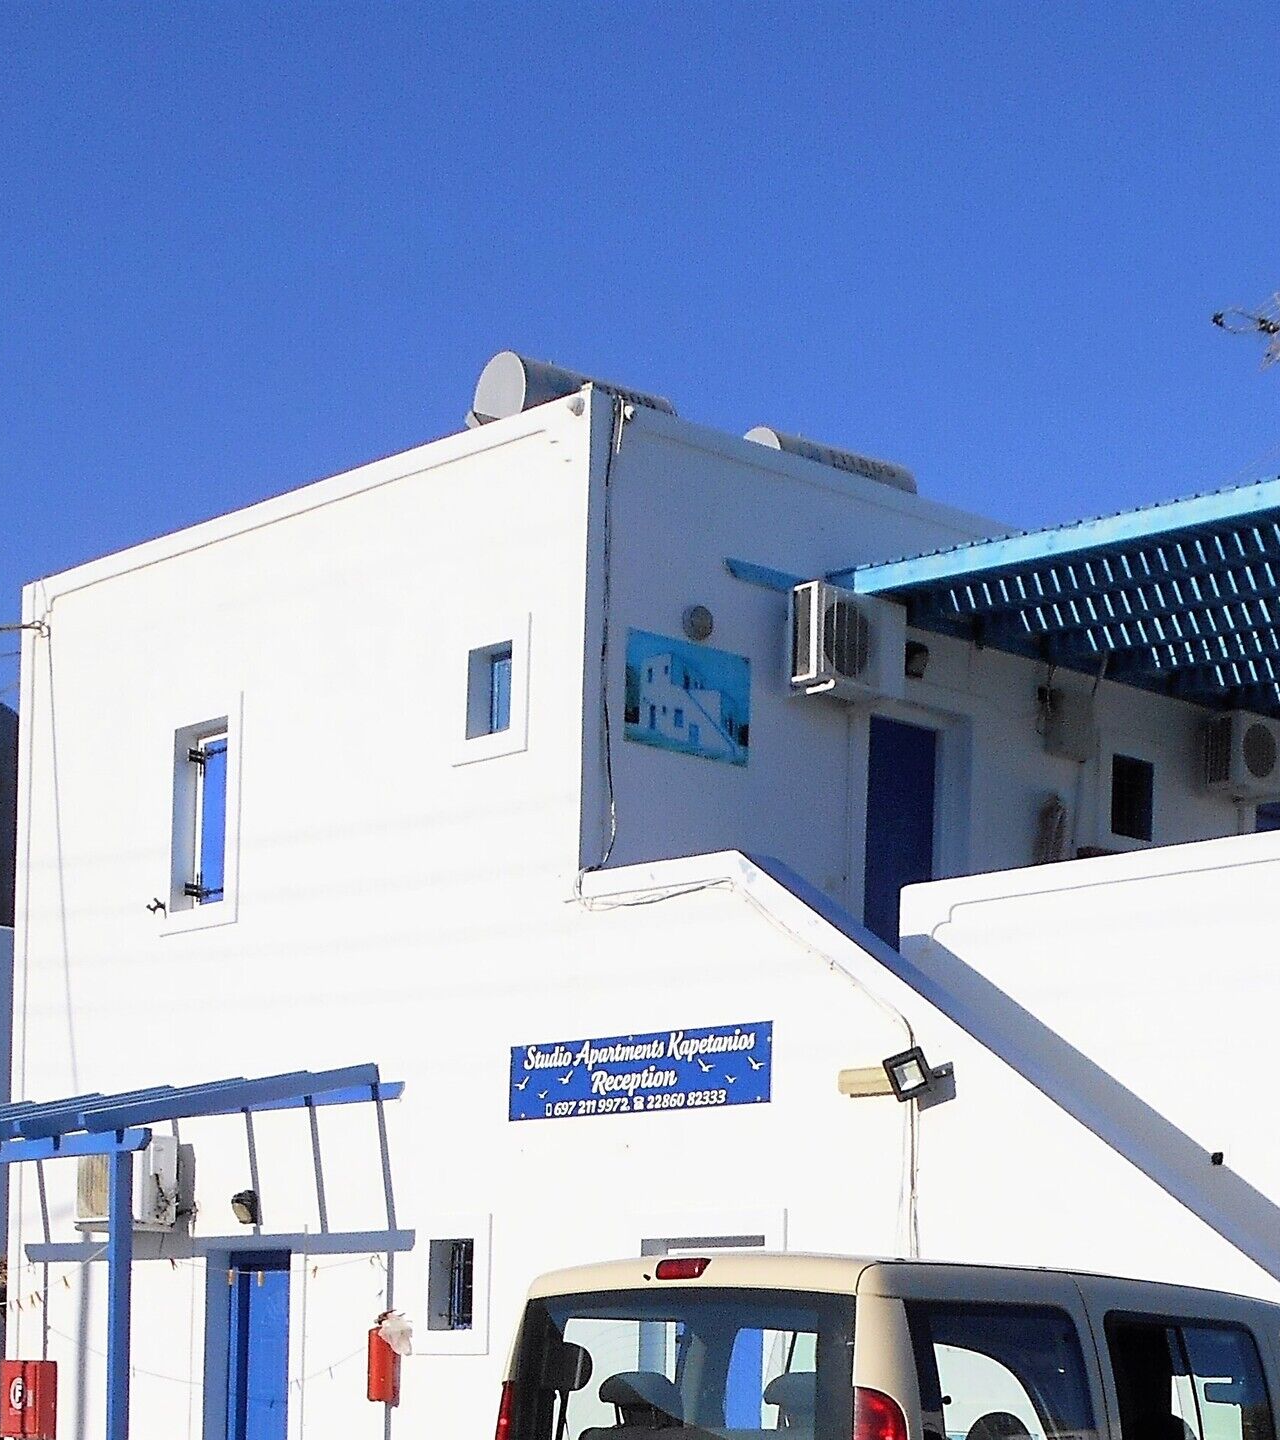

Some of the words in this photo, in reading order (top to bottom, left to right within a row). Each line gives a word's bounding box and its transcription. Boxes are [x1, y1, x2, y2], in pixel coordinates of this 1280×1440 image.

[524, 1045, 572, 1070] Studio
[573, 1041, 665, 1070] Apartments
[667, 1028, 756, 1061] Kapetanios
[591, 1066, 677, 1096] Reception
[554, 1101, 576, 1116] 697
[578, 1100, 596, 1114] 211
[646, 1093, 685, 1109] 22860
[687, 1089, 726, 1106] 82333
